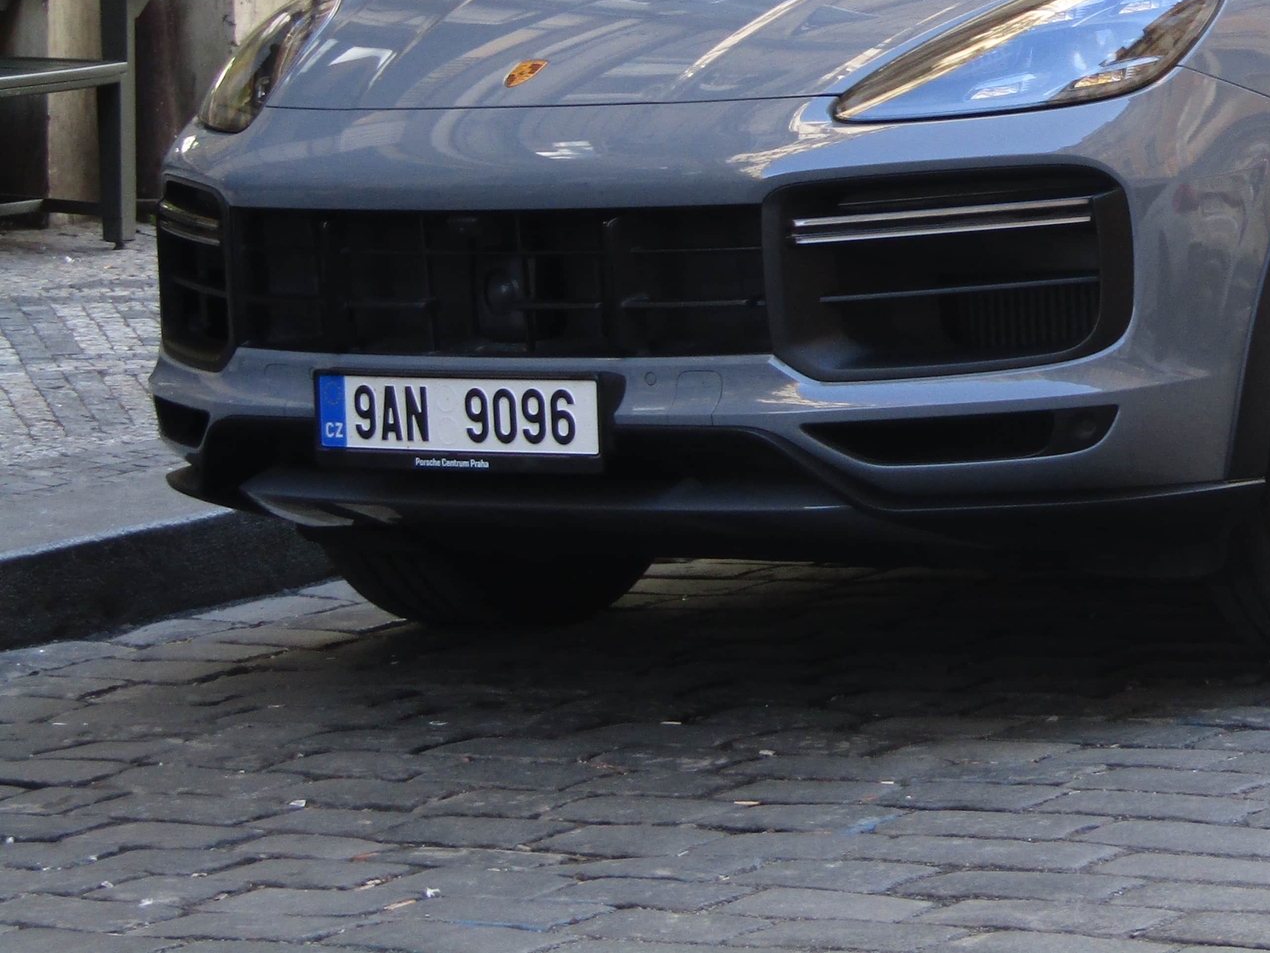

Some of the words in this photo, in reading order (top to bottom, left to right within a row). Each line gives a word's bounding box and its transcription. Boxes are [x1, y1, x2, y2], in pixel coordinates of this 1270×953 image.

[325, 421, 344, 439] CZ
[354, 384, 430, 443] 9AN
[464, 387, 577, 445] 9096
[415, 457, 441, 467] Porsche
[441, 458, 469, 468] Centrum
[470, 459, 489, 468] Praha
